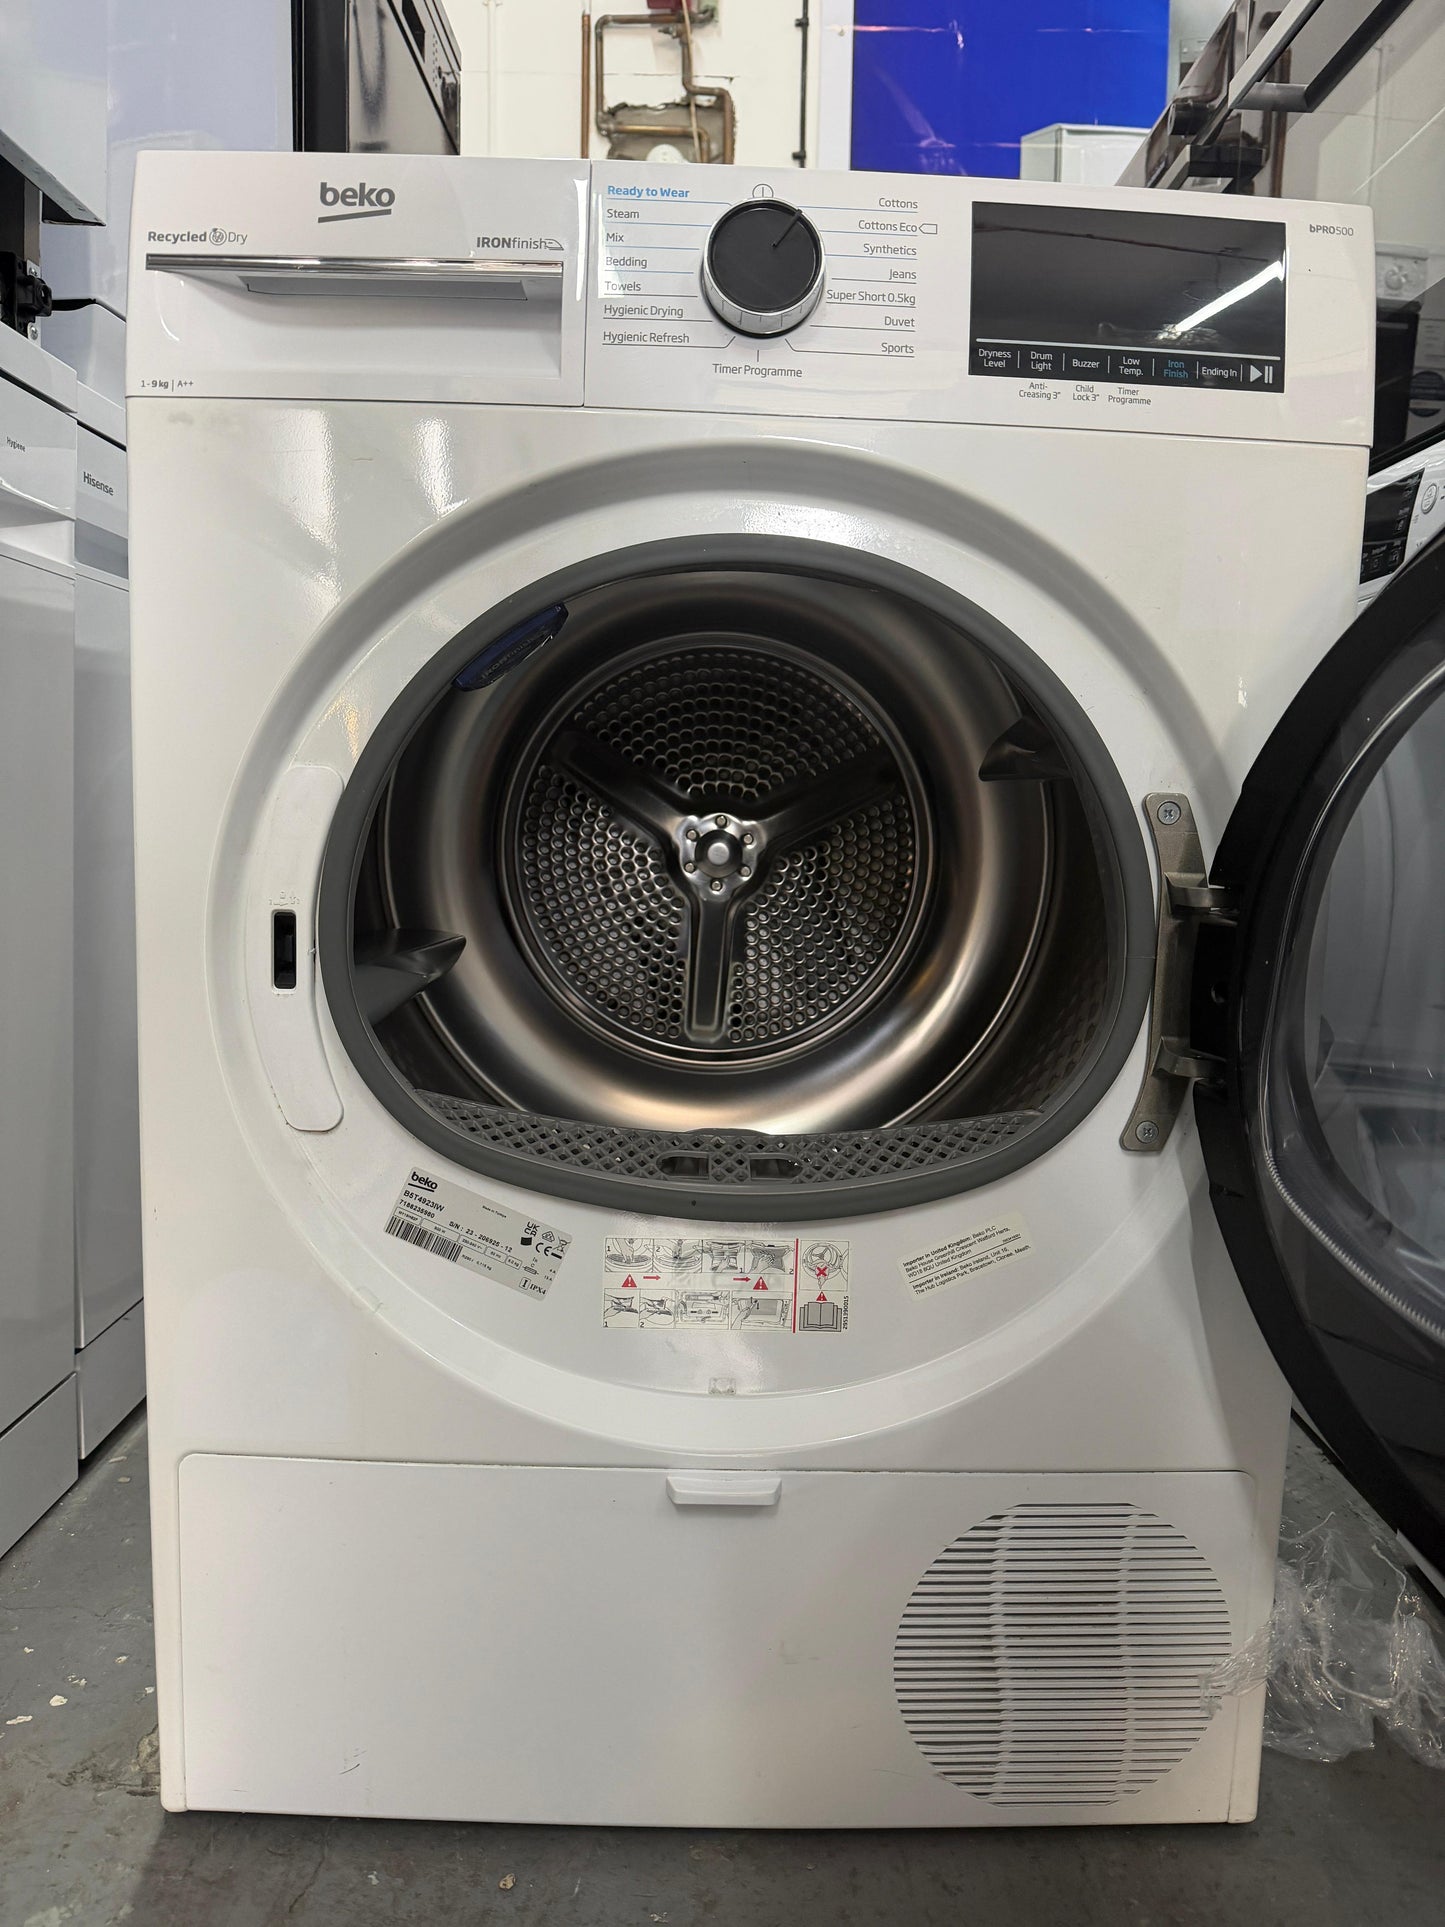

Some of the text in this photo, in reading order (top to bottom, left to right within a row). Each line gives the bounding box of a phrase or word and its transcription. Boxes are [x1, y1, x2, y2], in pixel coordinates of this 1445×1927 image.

[320, 182, 396, 208] beko
[607, 186, 690, 198] Ready to Wear
[878, 198, 918, 209] Cottons
[606, 209, 640, 219] Steam
[858, 220, 918, 232] Cottons Eco
[1309, 224, 1354, 236] bPRO500
[148, 231, 248, 245] Recycled Dry
[476, 237, 548, 249] IRONfinish
[606, 232, 624, 243] Mix
[863, 244, 917, 256] Synthetics
[606, 257, 647, 269] Bedding
[889, 269, 917, 280] Jeans
[605, 281, 642, 291] Towels
[827, 290, 916, 305] Super Short 0.5kg
[604, 305, 684, 318] Hygienic Drying
[884, 317, 915, 327] Duvet
[603, 331, 690, 344] Hygienic Refresh
[881, 343, 915, 355] Sports
[978, 348, 1012, 359] Dryness
[1030, 351, 1053, 360] Drum
[1123, 356, 1140, 366] Low
[984, 359, 1006, 368] Level
[1031, 361, 1052, 371] Light
[1072, 359, 1100, 369] Buzzer
[1168, 360, 1185, 368] Iron
[712, 364, 802, 378] Timer Programme
[1119, 366, 1144, 376] Temp.
[1163, 369, 1189, 378] Finish
[1202, 366, 1237, 379] Ending In
[1029, 382, 1048, 390] Anti-
[1076, 384, 1094, 393] Child
[1117, 387, 1139, 396] Timer
[1019, 390, 1051, 400] Creasing
[1073, 393, 1090, 402] Lock
[1108, 395, 1152, 405] Programme
[83, 471, 114, 496] Hisense
[411, 1171, 438, 1190] beko
[403, 1190, 445, 1212] B5T4923IW
[903, 1255, 924, 1267] Importer
[931, 1246, 947, 1257] United
[935, 1257, 951, 1267] United
[951, 1249, 972, 1263] Kingdom
[918, 1259, 933, 1268] House
[529, 1283, 547, 1295] IPX4
[915, 1287, 925, 1295] The
